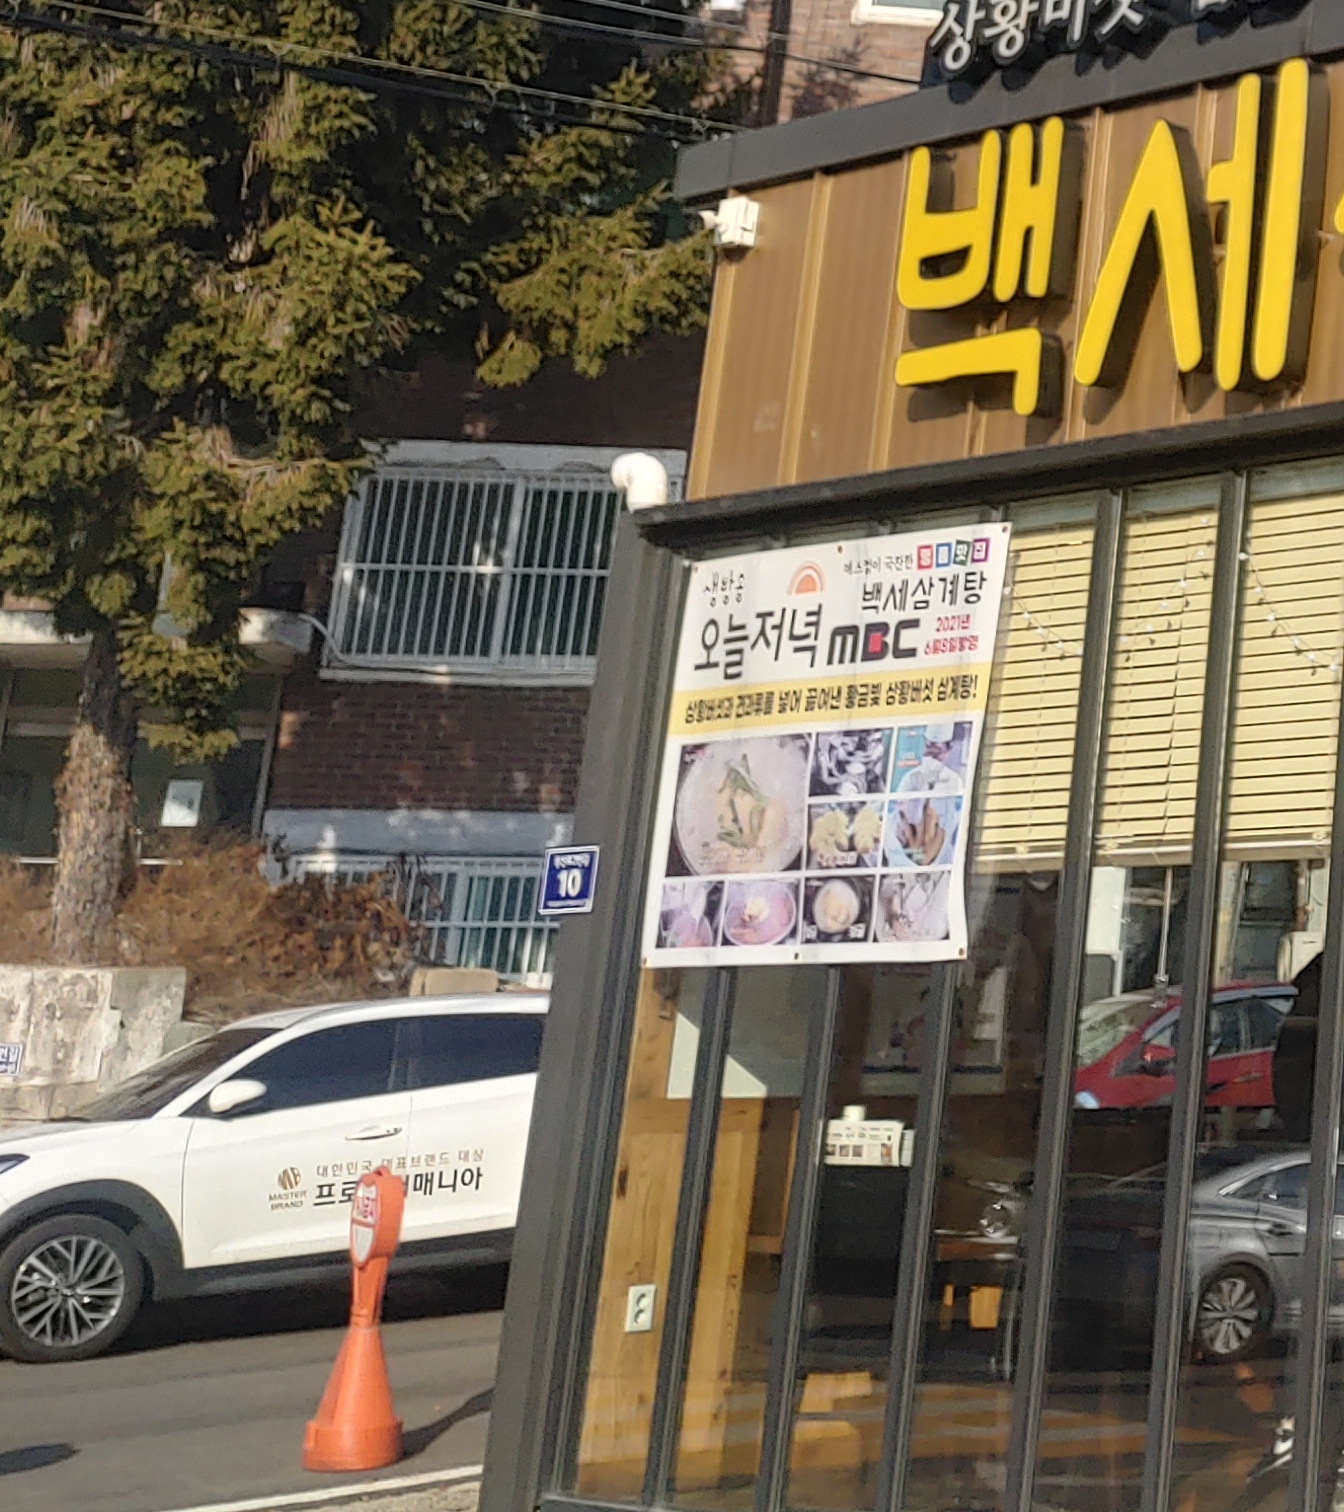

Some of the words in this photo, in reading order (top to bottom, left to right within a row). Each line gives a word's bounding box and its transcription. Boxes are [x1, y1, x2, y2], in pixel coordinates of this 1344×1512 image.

[703, 570, 745, 607] 생방송
[862, 570, 988, 615] 백세삼계탕
[936, 614, 970, 633] 2021년
[694, 603, 823, 680] 오늘저녁
[827, 618, 920, 666] MBC
[845, 682, 883, 708] 황금빛
[885, 678, 935, 705] 상황버섯
[936, 674, 979, 701] 삼계탕!
[557, 868, 582, 897] 10
[315, 1159, 373, 1178] 대한민국
[458, 1148, 485, 1164] 대상
[268, 1190, 308, 1201] MASTER
[270, 1199, 304, 1211] BRAND
